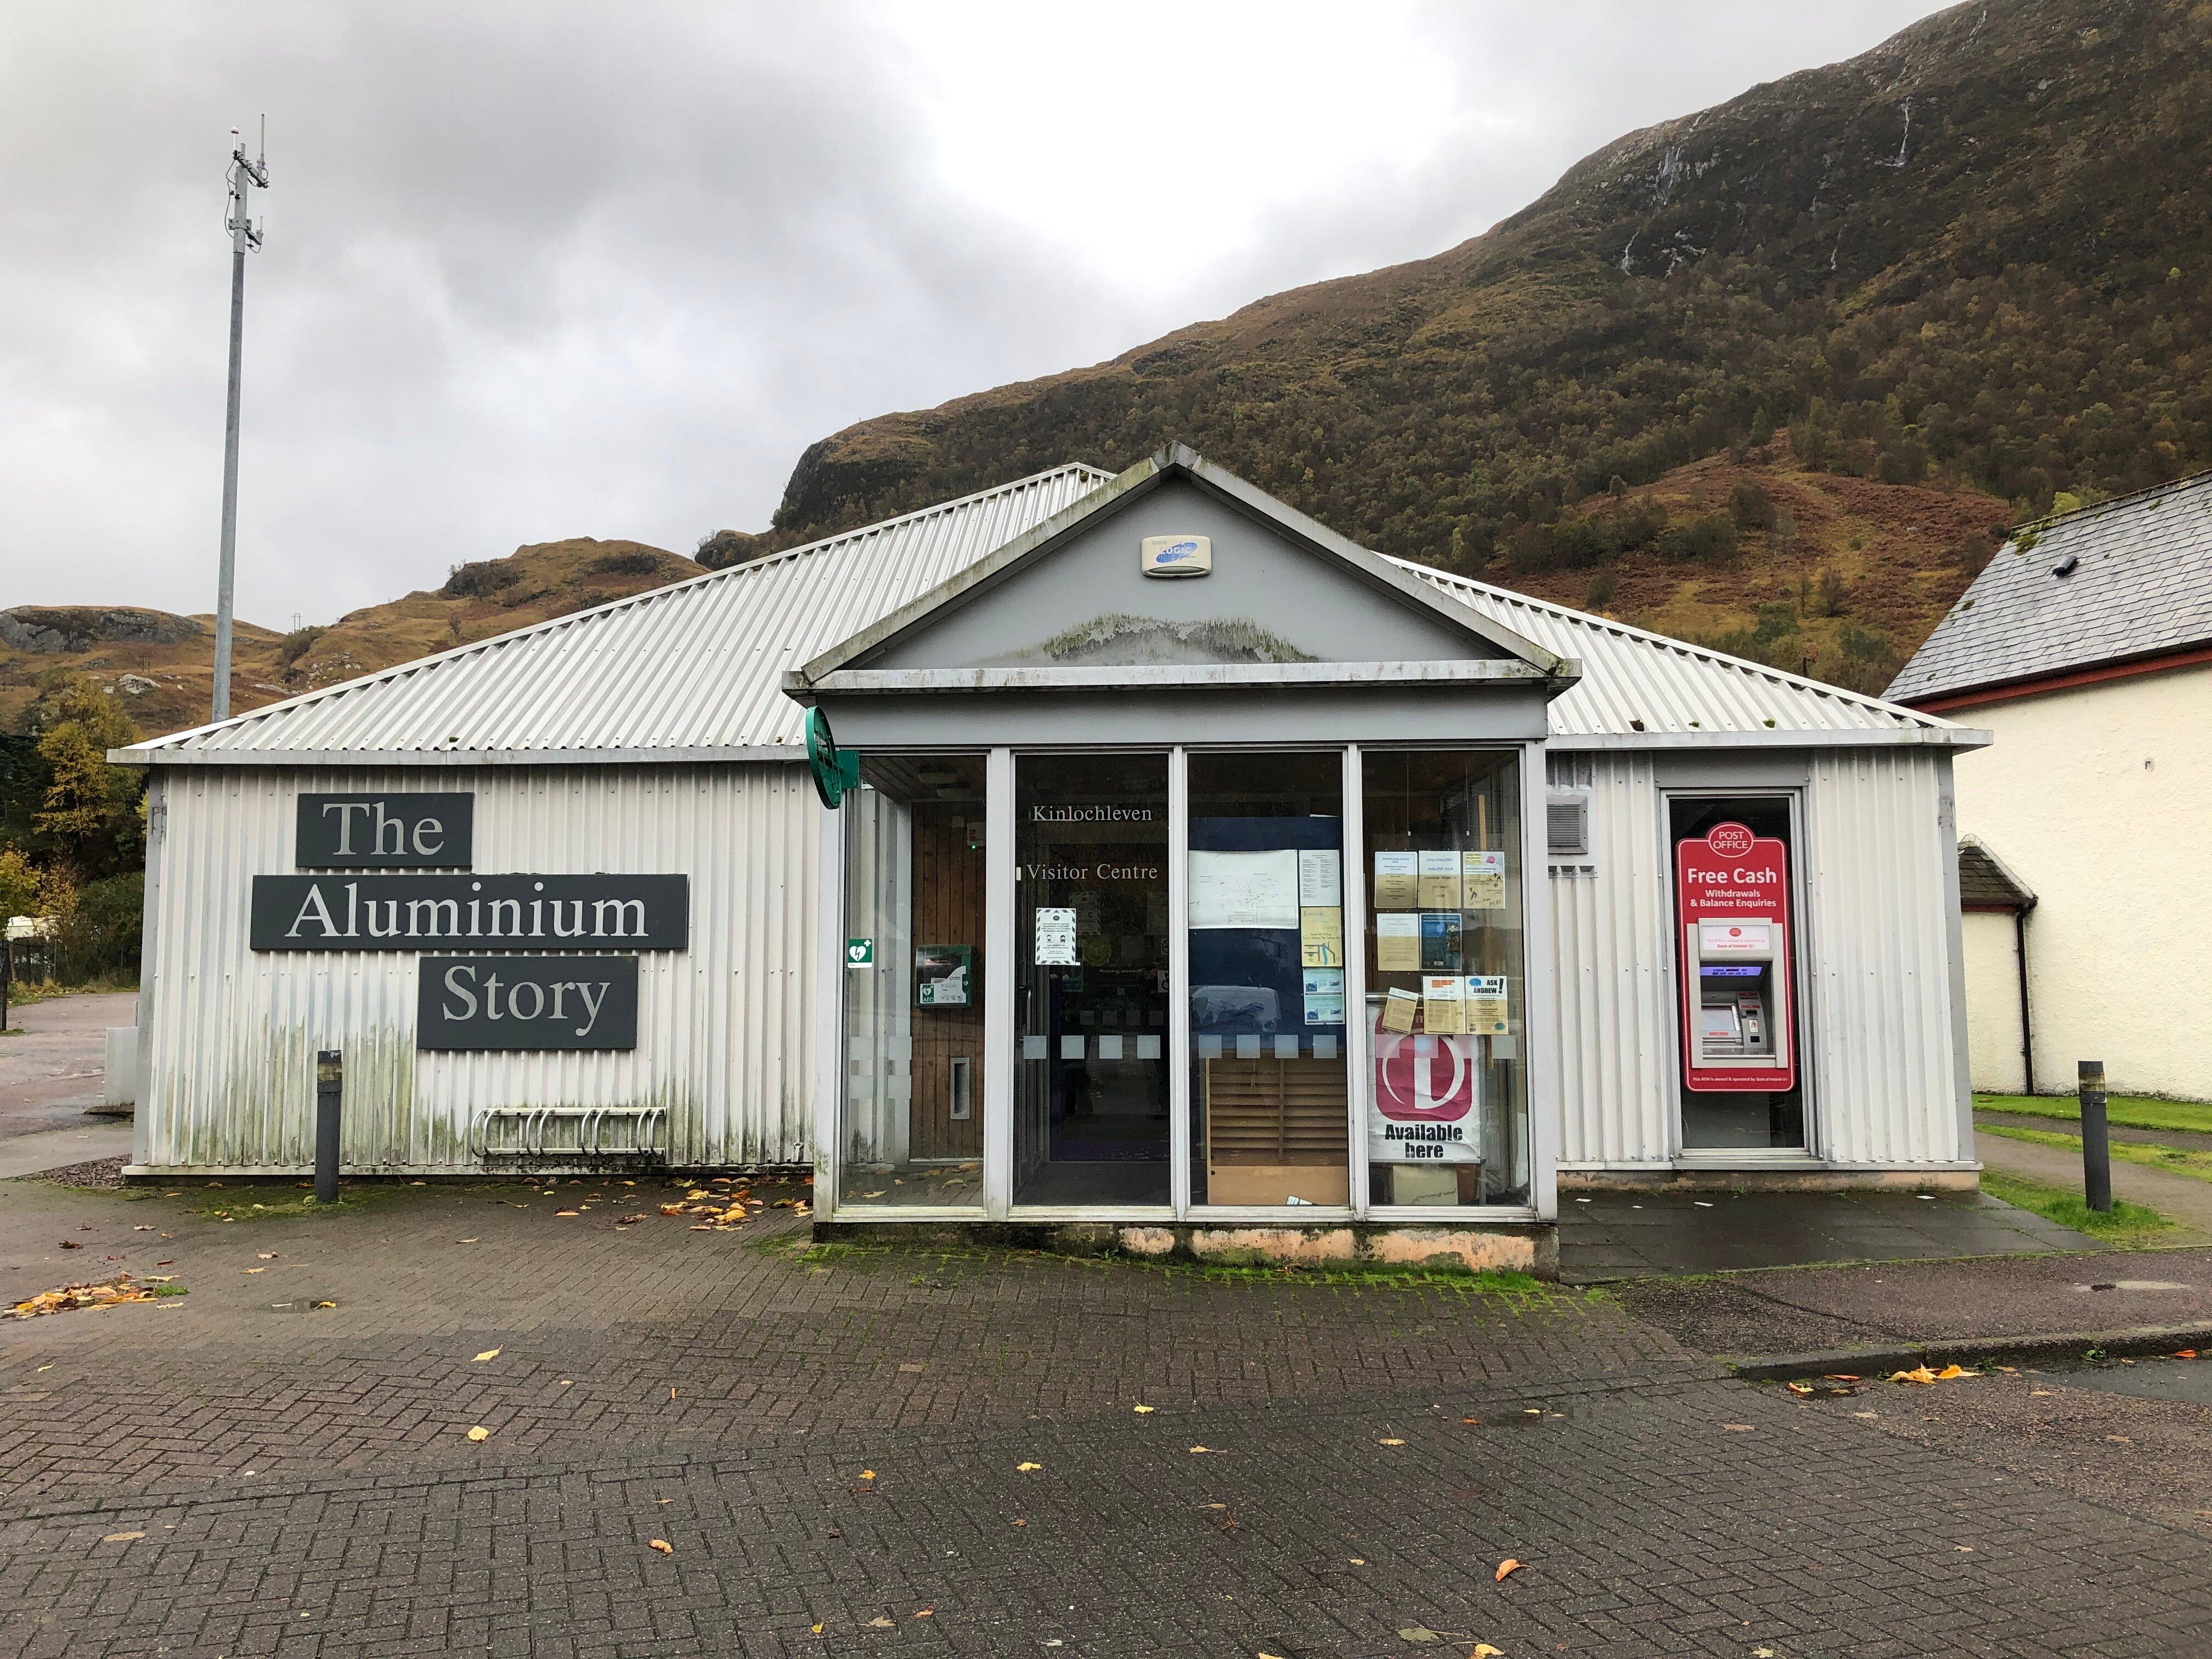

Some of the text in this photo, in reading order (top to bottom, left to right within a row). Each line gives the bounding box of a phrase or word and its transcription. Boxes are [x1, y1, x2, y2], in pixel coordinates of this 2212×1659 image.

[1032, 805, 1153, 821] Kinlochleven
[323, 801, 445, 856] The
[1718, 831, 1745, 840] POST
[1713, 840, 1748, 849] OFFICE
[1026, 864, 1158, 879] Visitor Centre
[1688, 867, 1778, 884] Free Cash
[1705, 889, 1760, 898] Withdrawals
[284, 882, 650, 938] Aluminium
[1690, 899, 1776, 909] & Balance Enquiries
[442, 965, 612, 1036] Story
[1385, 1124, 1463, 1141] Available
[1405, 1143, 1444, 1159] here
